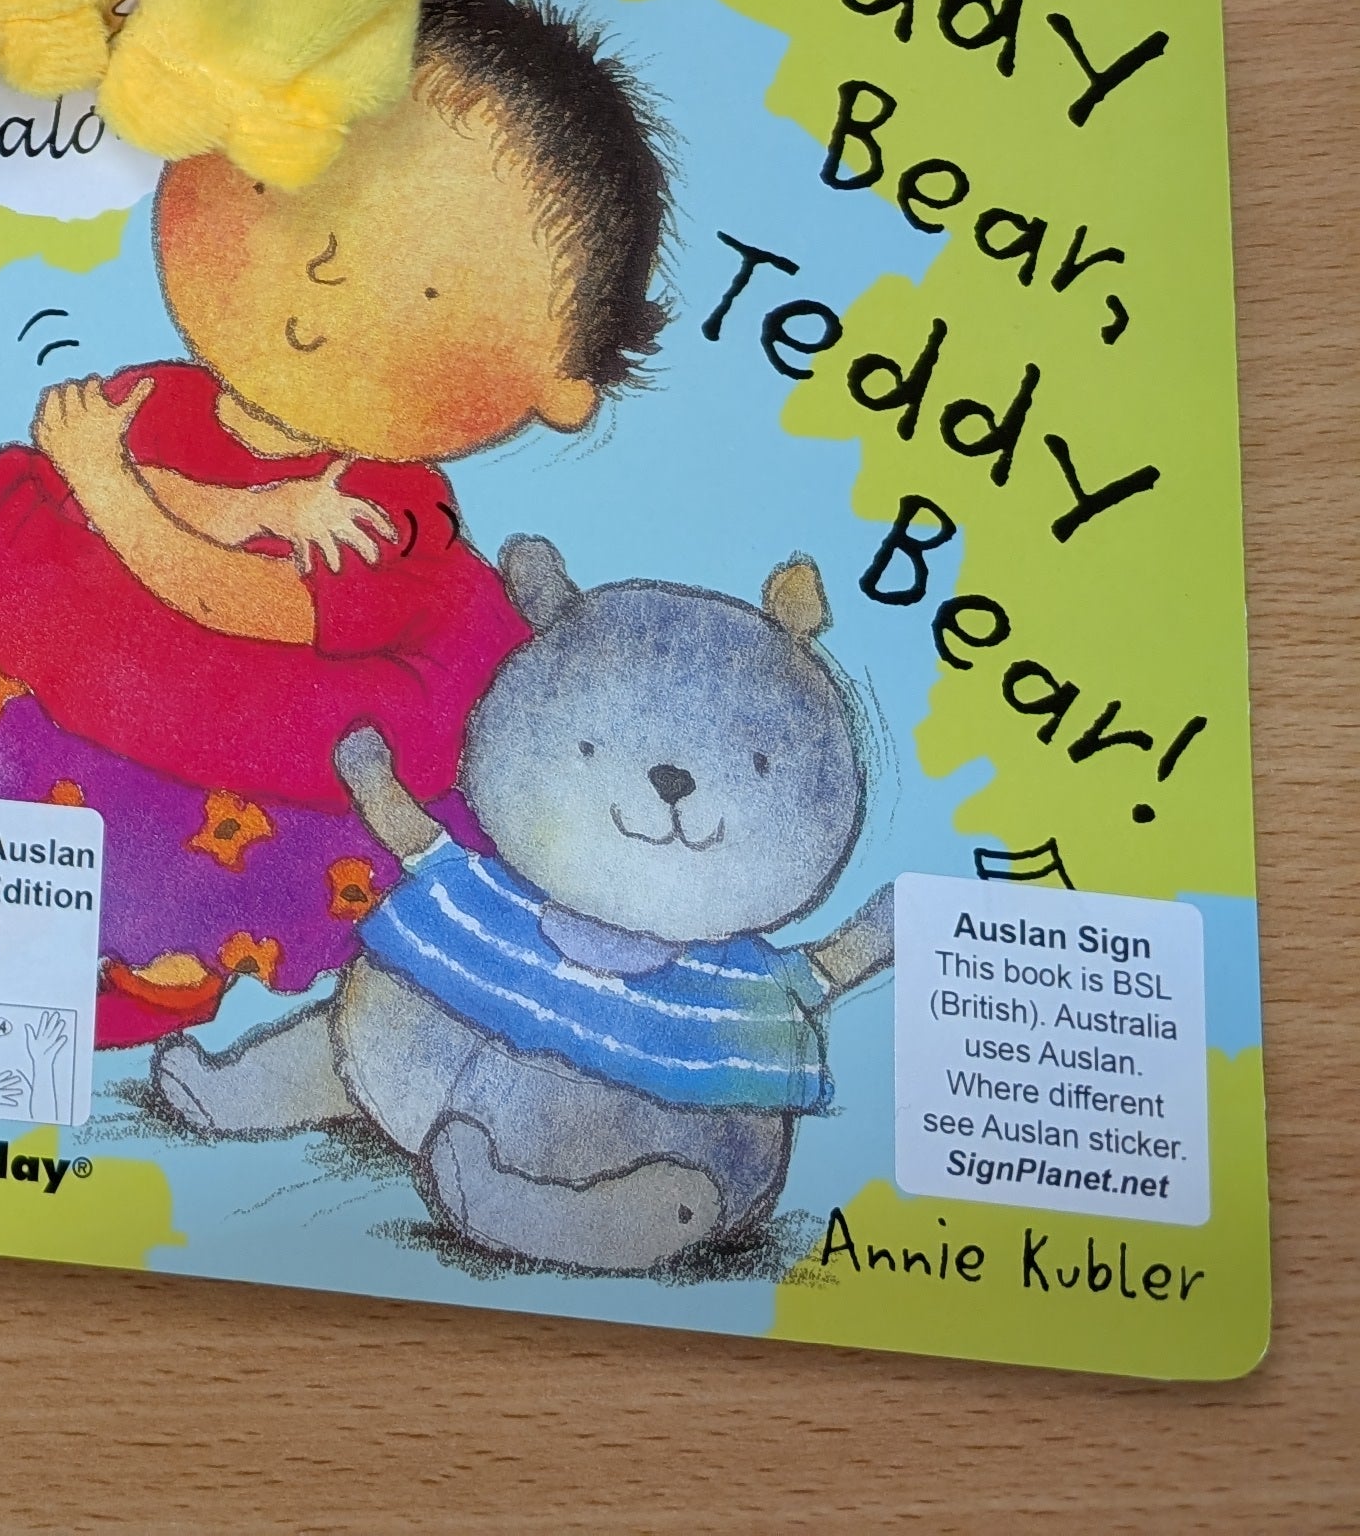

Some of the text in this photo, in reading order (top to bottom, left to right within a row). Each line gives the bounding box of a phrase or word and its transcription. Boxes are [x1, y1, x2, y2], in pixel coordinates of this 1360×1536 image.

[819, 80, 1130, 346] Bear,
[701, 230, 1161, 543] Teddy
[859, 494, 1208, 825] Bear!
[953, 912, 1152, 963] Auslan Sign
[935, 950, 1173, 1001] This book is BSL
[930, 989, 1178, 1041] (British). Australia
[965, 1038, 1143, 1076] uses Auslan.
[946, 1069, 1165, 1118] Where different
[923, 1112, 1188, 1161] see Auslan sticker.
[946, 1149, 1170, 1199] SignPlanet.net
[821, 1206, 1205, 1302] Annie Kubler
